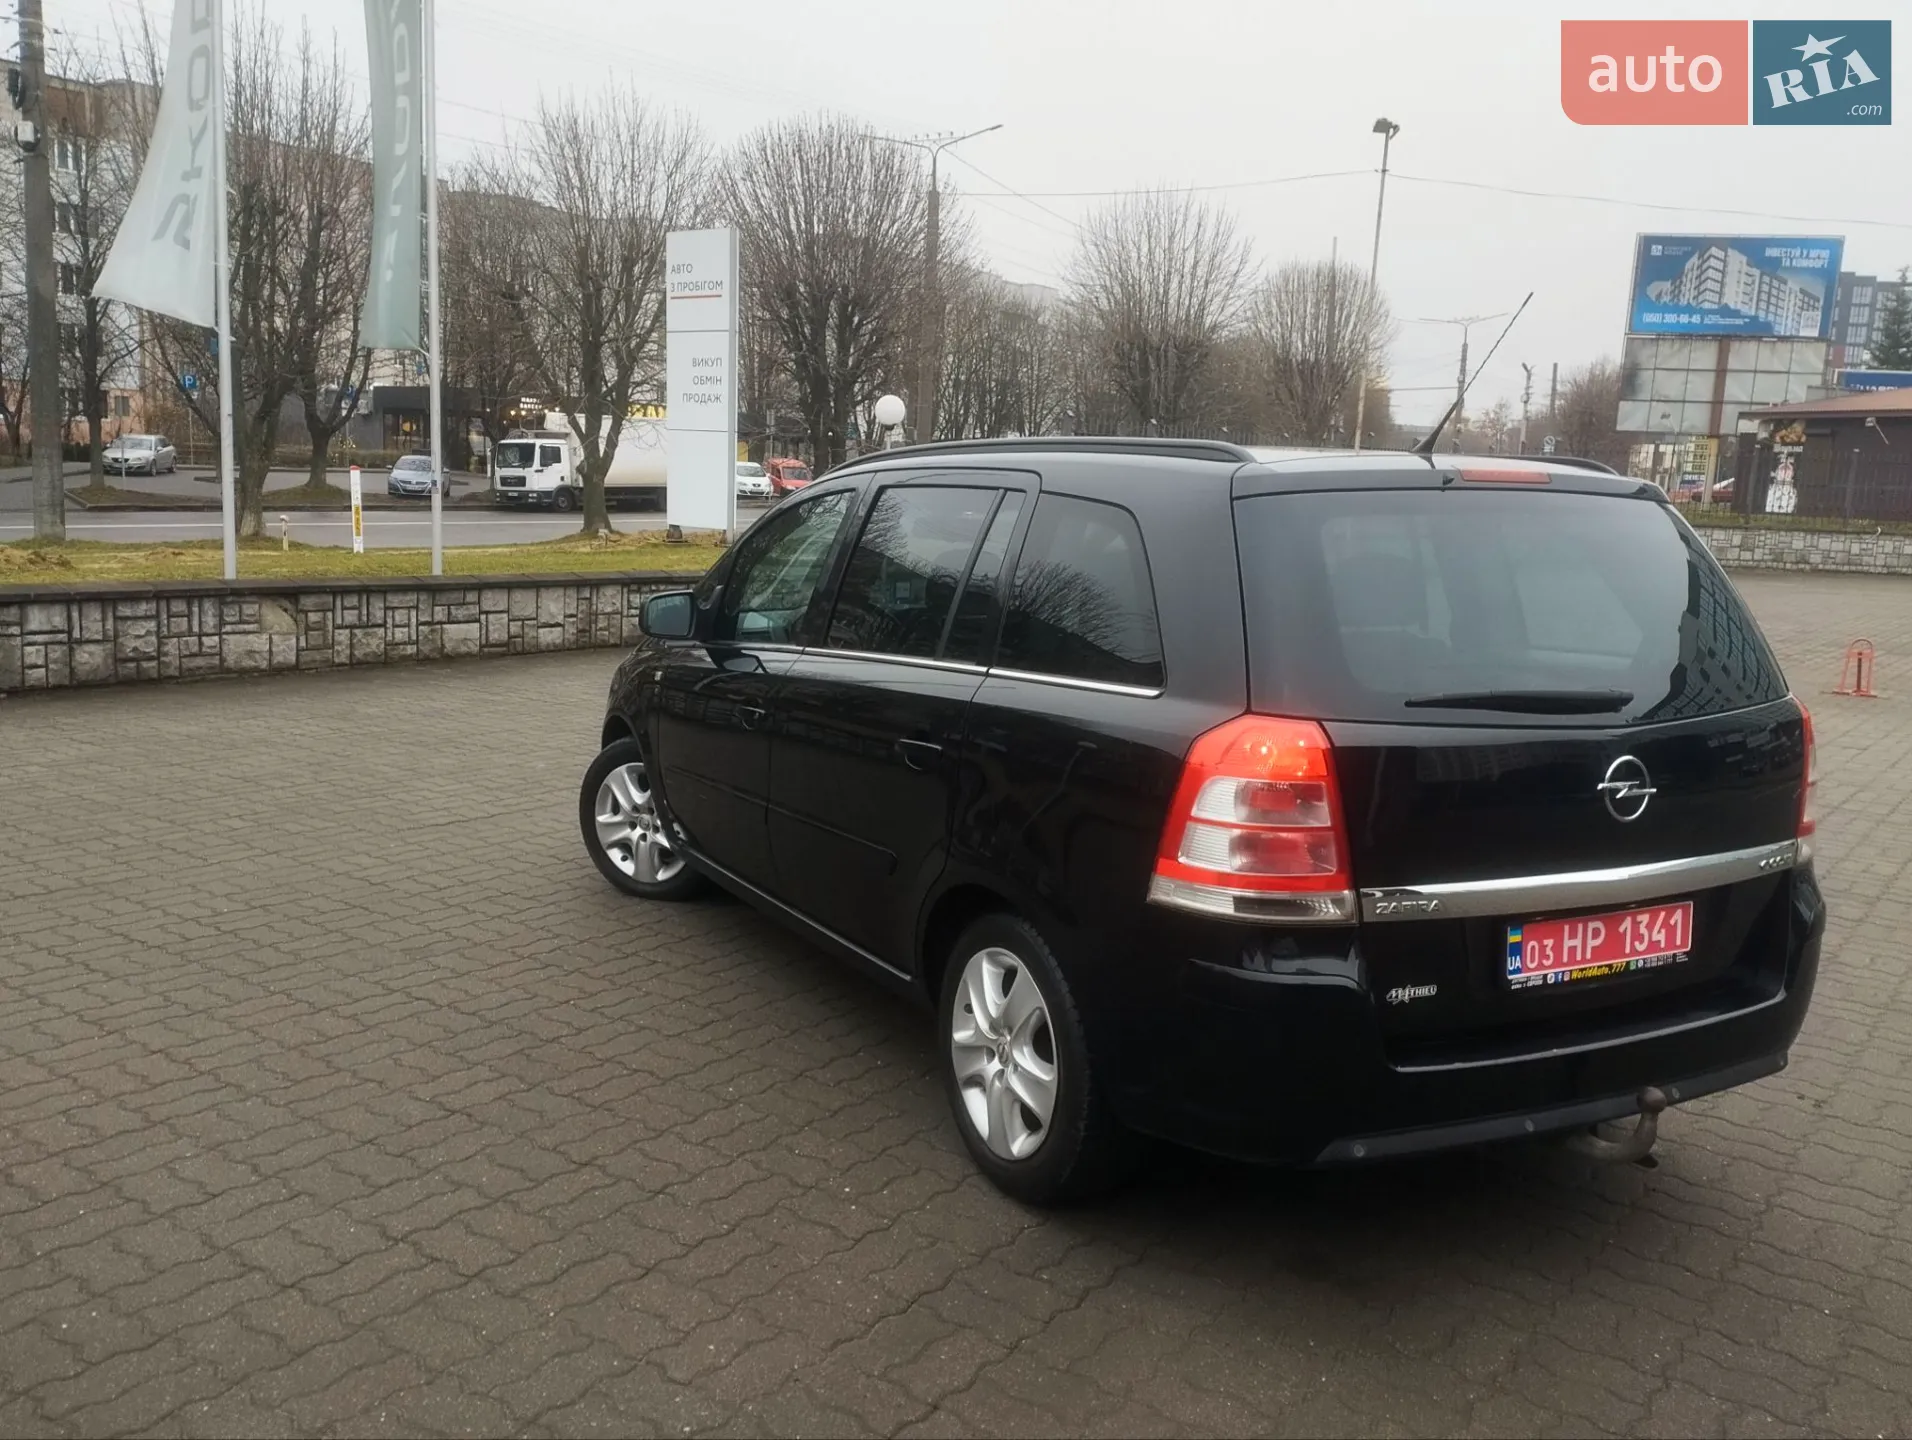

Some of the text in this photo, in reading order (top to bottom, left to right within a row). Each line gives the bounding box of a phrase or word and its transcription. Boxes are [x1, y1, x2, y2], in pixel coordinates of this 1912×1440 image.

[670, 263, 693, 274] АВТО
[677, 280, 723, 292] ПРОБІГОМ
[692, 357, 722, 368] ВИКУП
[185, 375, 194, 388] P
[692, 375, 722, 385] ОБМІН
[682, 392, 722, 405] ПРОДАЖ
[1376, 899, 1440, 914] ZAFIRA
[1526, 908, 1683, 969] 03 HP 1341
[1508, 955, 1522, 970] UA
